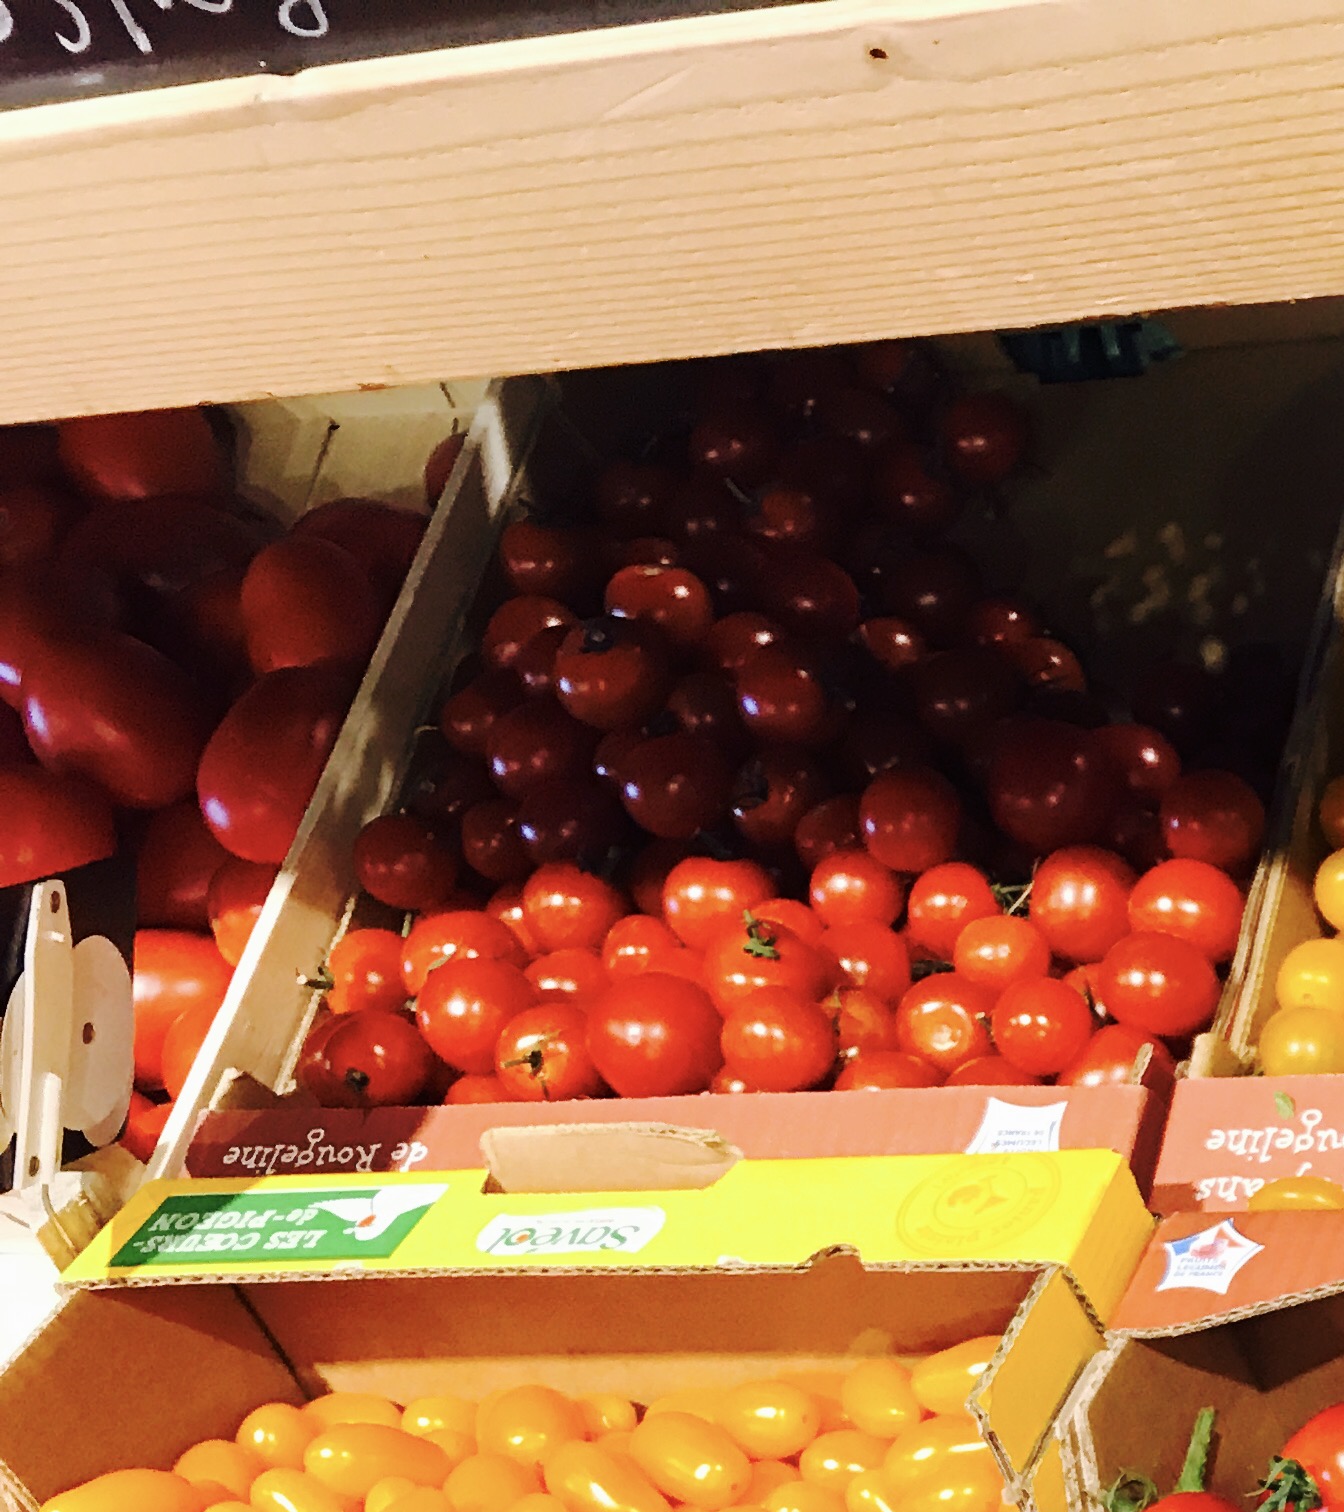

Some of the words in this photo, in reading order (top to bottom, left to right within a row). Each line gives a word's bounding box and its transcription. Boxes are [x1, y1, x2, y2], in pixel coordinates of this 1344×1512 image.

[223, 1128, 383, 1175] Rougeline
[391, 1141, 428, 1173] de
[148, 1207, 320, 1232] de-PIGEON
[262, 1229, 328, 1250] LES
